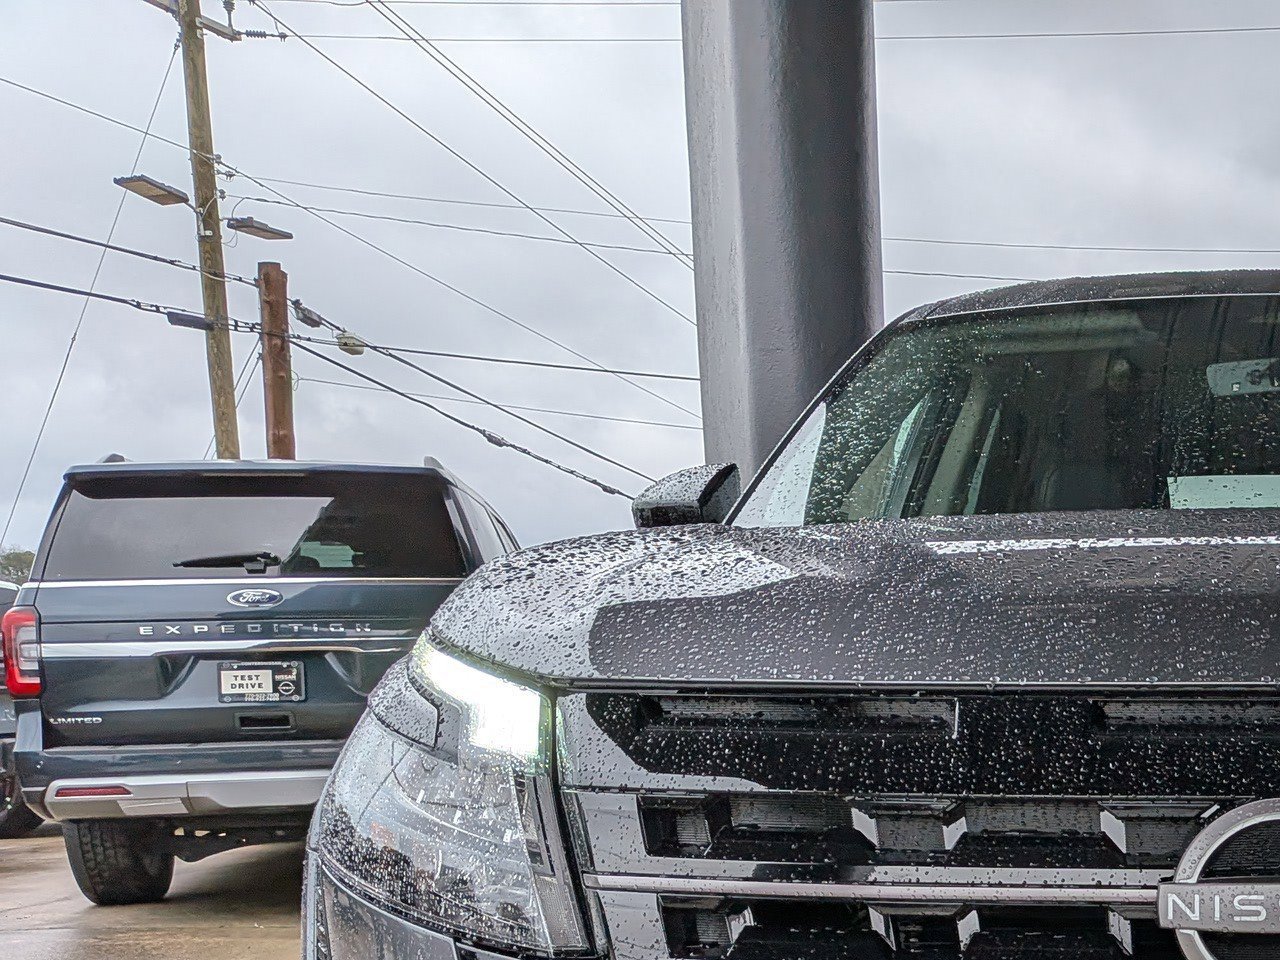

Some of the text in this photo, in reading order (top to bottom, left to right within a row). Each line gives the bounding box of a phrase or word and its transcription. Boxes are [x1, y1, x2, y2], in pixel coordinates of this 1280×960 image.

[239, 592, 270, 603] Ford
[139, 623, 371, 634] EXPEDITION
[50, 717, 103, 725] LIMITED
